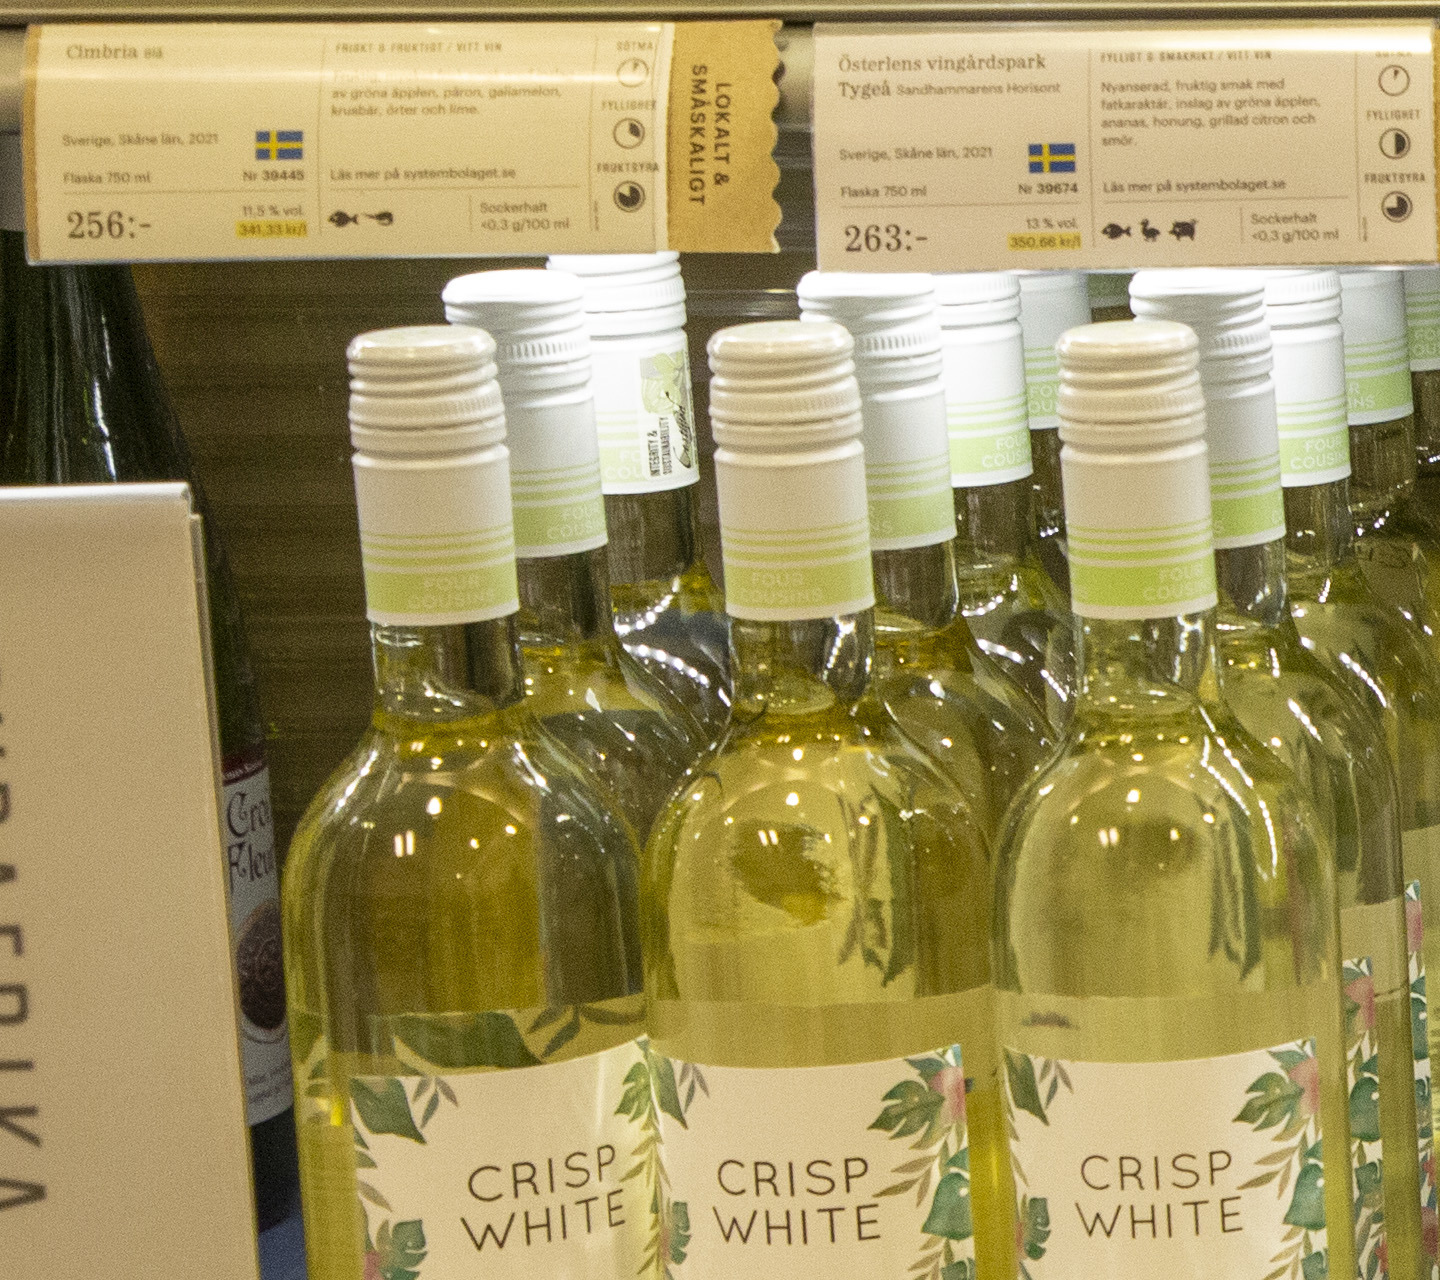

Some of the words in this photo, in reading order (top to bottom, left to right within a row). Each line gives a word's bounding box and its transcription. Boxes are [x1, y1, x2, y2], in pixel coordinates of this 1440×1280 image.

[838, 52, 921, 72] Österlens
[925, 51, 1046, 73] vingårdspark
[838, 77, 891, 99] Tygeå
[688, 64, 707, 206] SMÅSKALIGT
[715, 82, 731, 162] LOKALT
[467, 1143, 618, 1204] CRISP
[717, 1156, 869, 1197] CRISP
[1080, 1150, 1233, 1191] CRISP
[460, 1188, 627, 1253] WHITE
[712, 1203, 881, 1246] WHITE
[1076, 1196, 1245, 1240] WHITE
